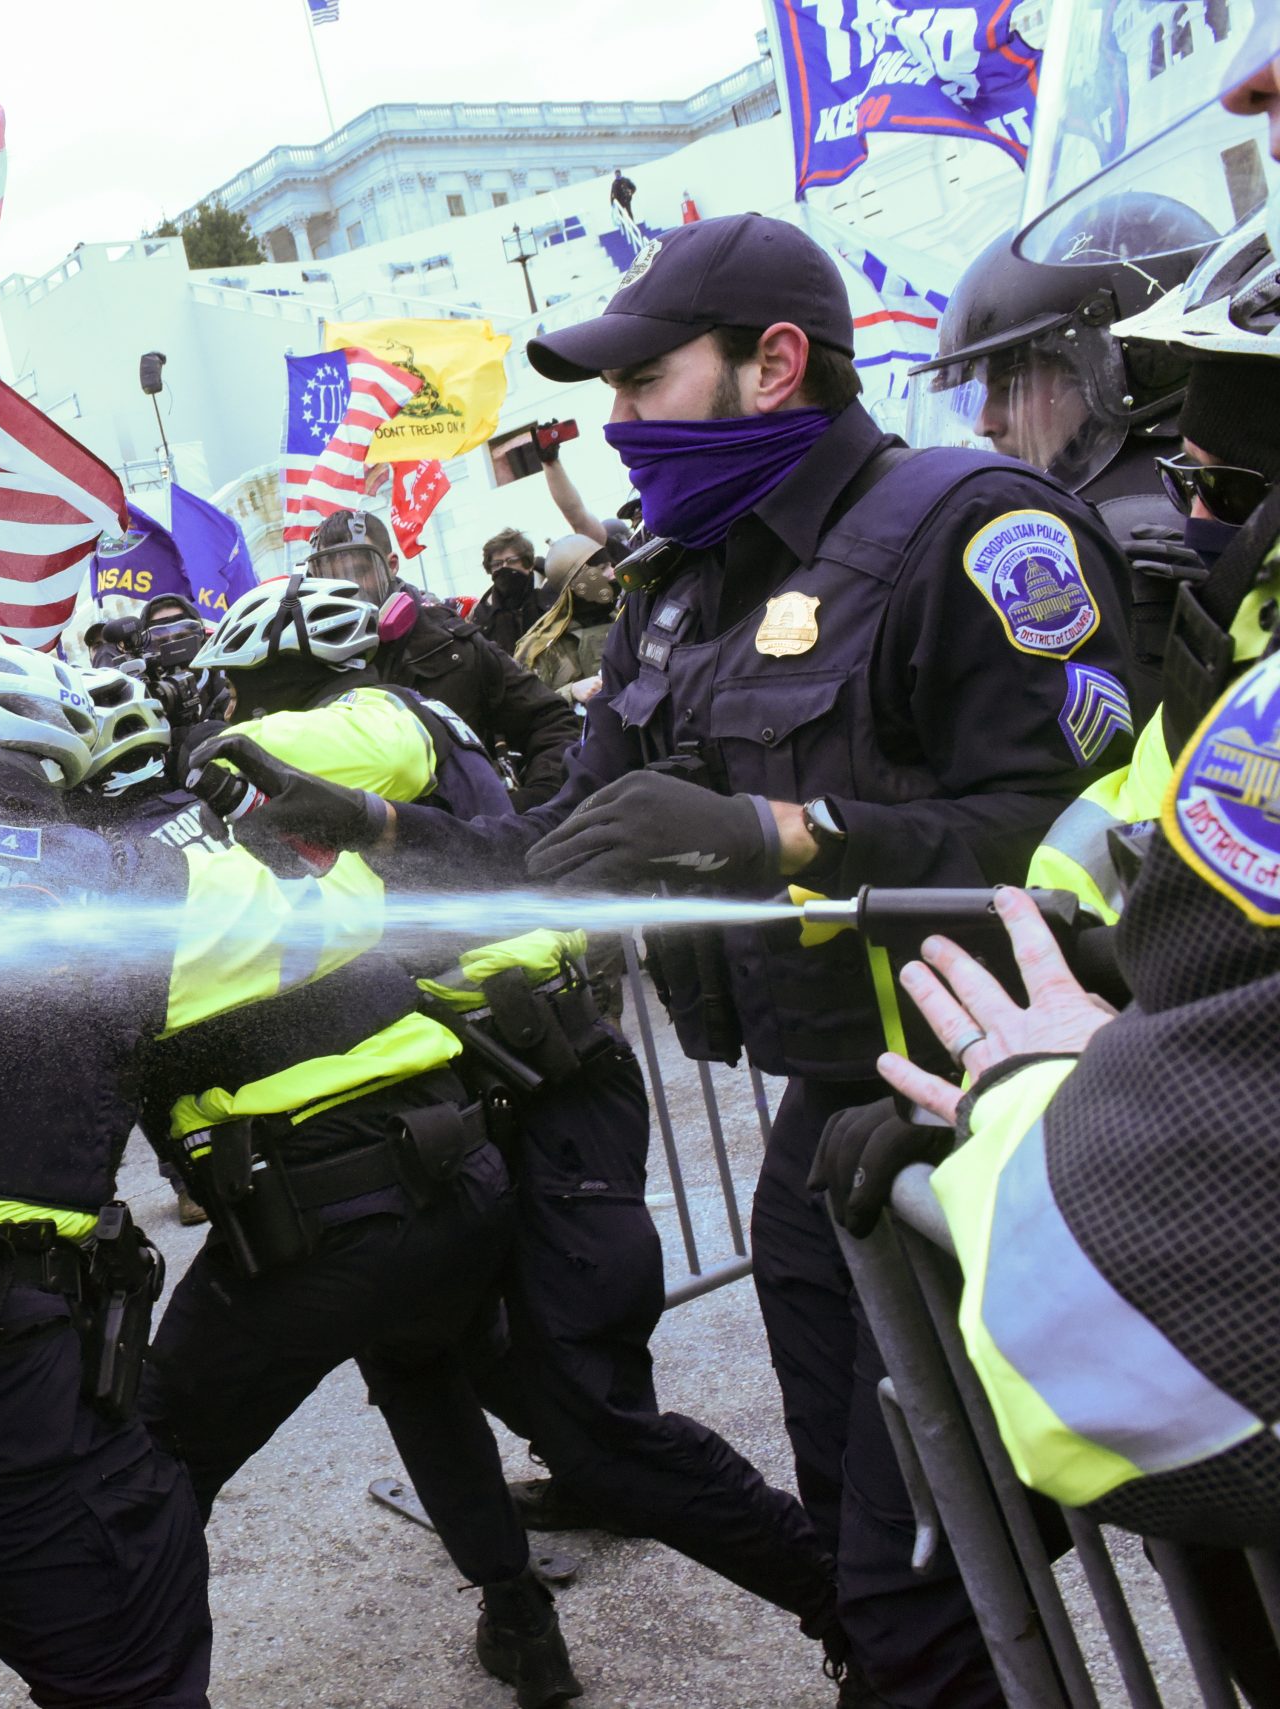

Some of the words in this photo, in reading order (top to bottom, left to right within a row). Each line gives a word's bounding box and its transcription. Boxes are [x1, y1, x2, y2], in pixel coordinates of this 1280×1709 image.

[409, 422, 444, 437] TREAD
[447, 421, 459, 433] ON
[974, 523, 1035, 574] METROPOLITAN
[1037, 523, 1067, 548] POLICE
[999, 551, 1026, 579] JUSTITIA
[1026, 546, 1062, 562] OMNIBUS
[98, 568, 154, 593] NSAS
[198, 587, 230, 612] KA
[1020, 629, 1056, 646] DISTRICT
[1056, 636, 1065, 644] of
[1185, 800, 1260, 877] DISTRICT
[1255, 864, 1280, 887] of
